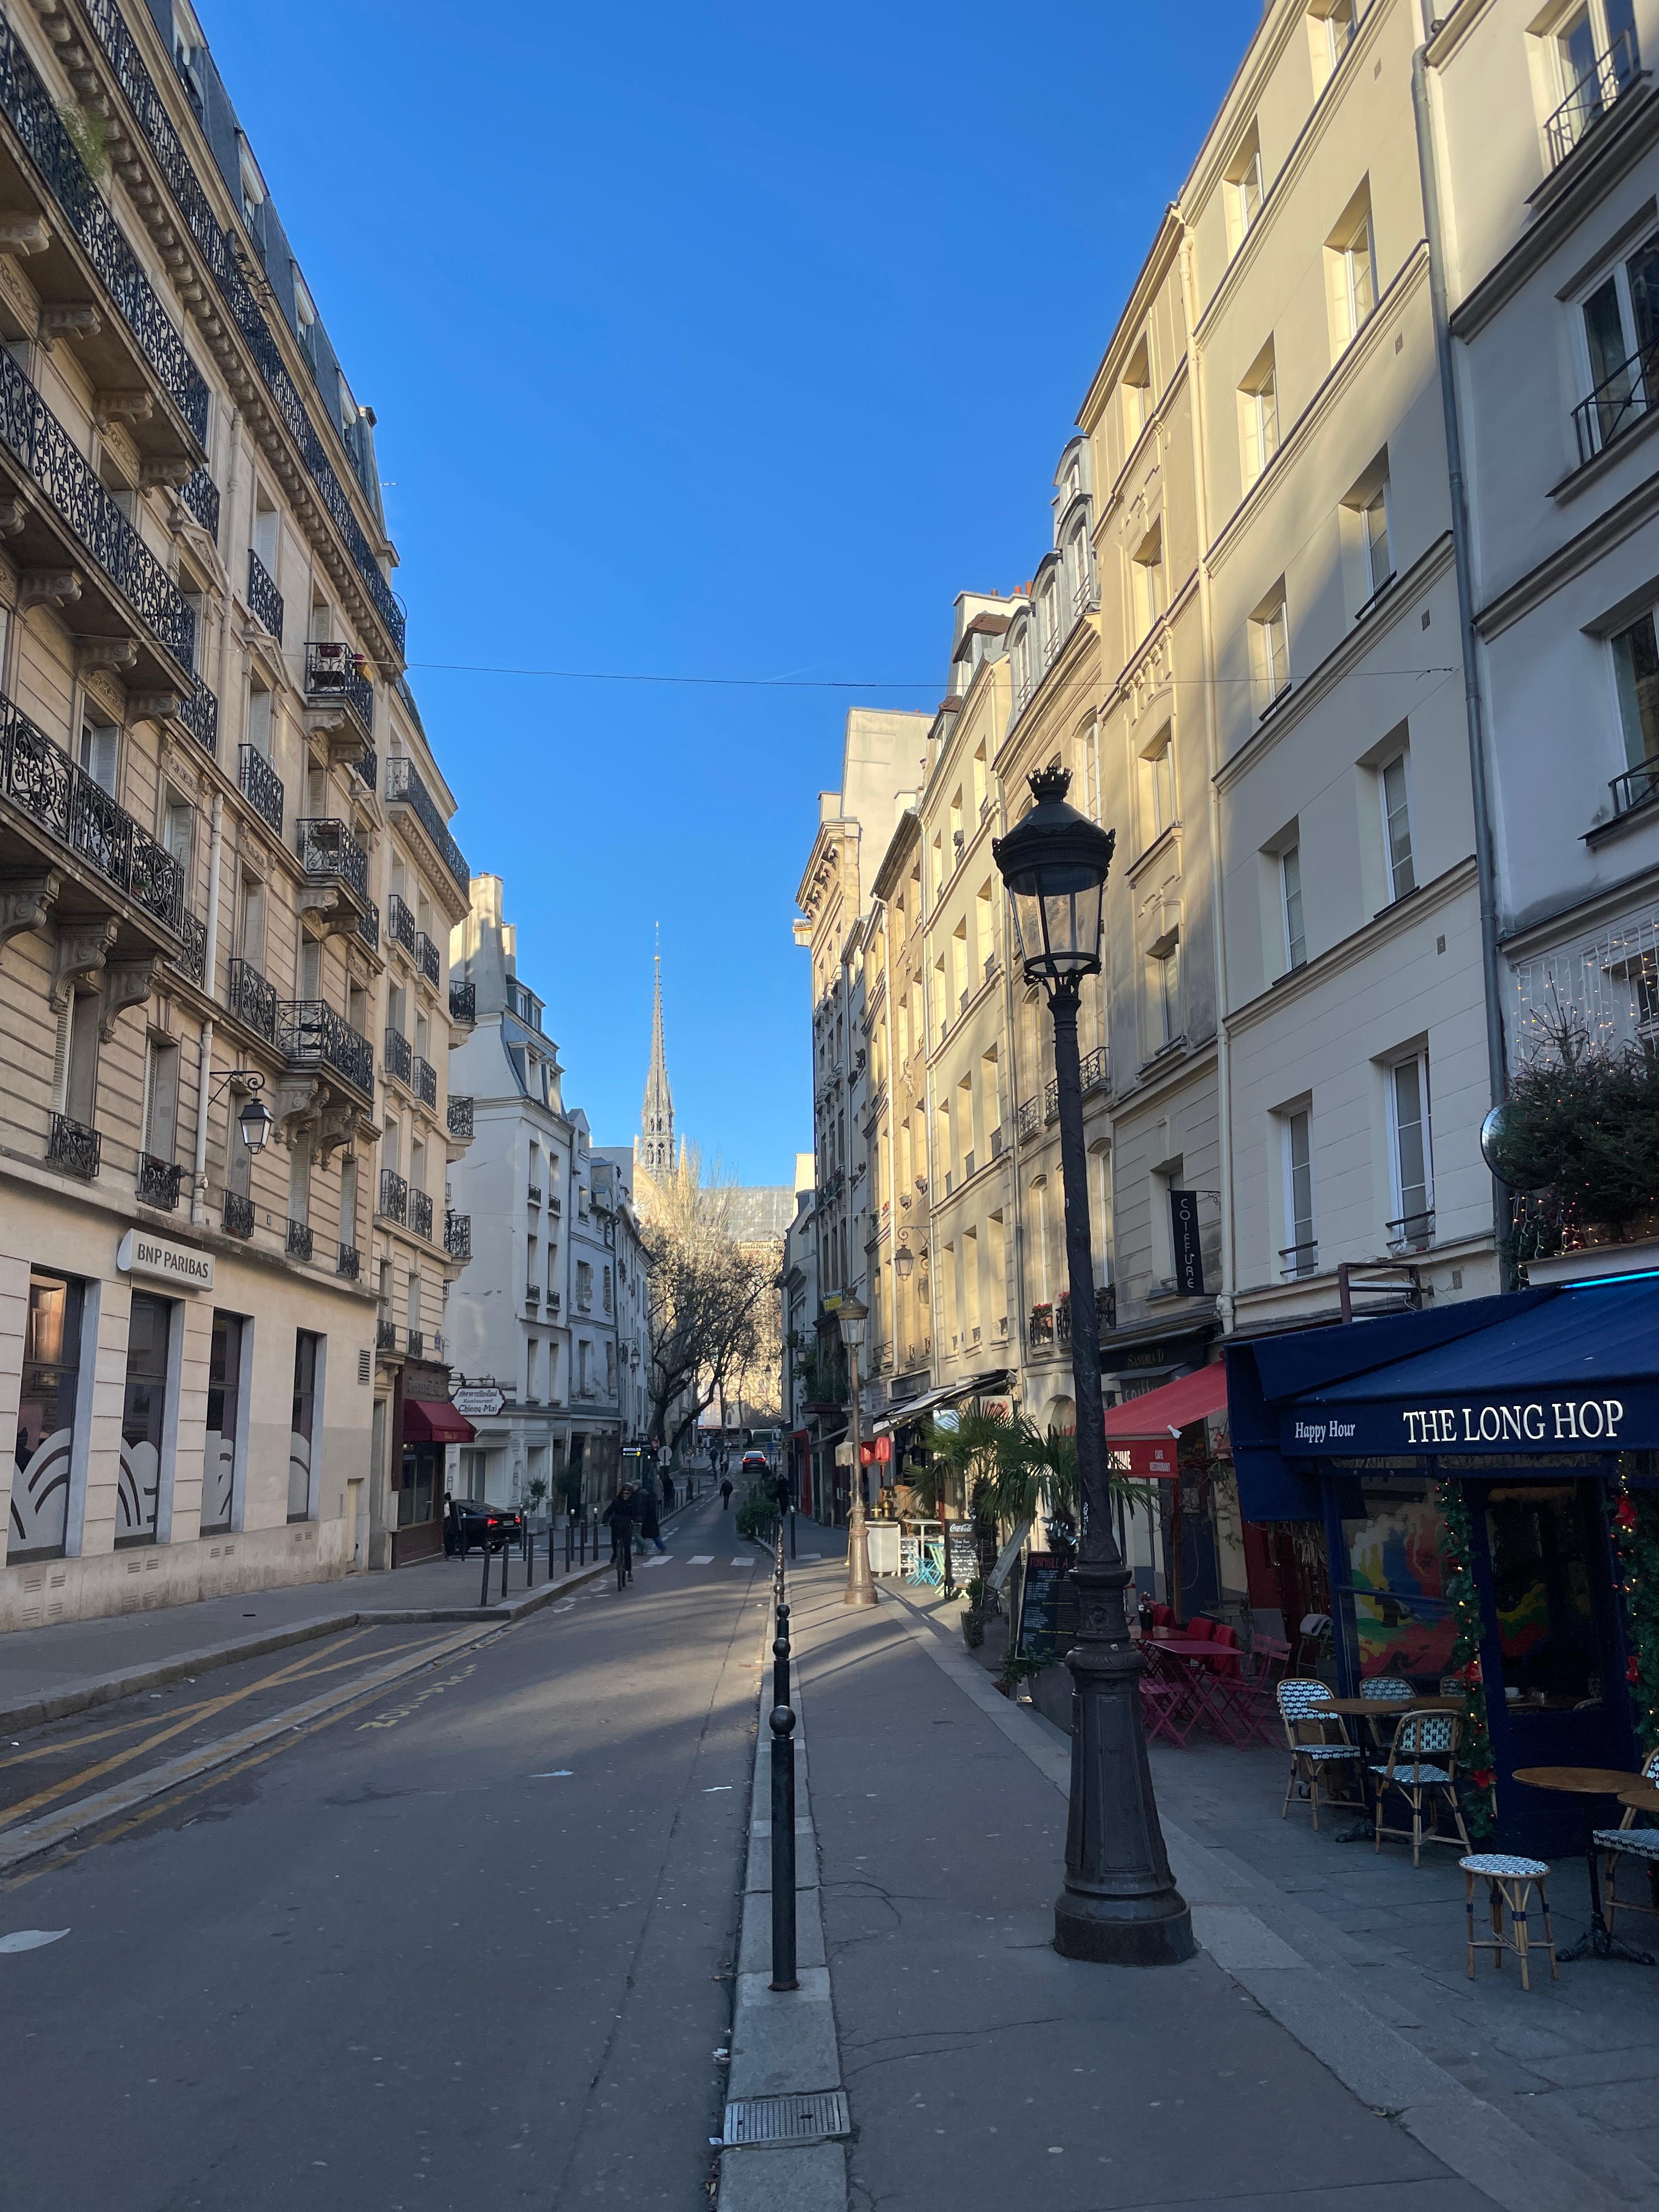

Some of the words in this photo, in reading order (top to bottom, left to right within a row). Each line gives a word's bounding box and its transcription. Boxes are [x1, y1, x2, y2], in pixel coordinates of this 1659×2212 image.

[138, 1243, 162, 1264] BNP
[164, 1251, 208, 1278] PARIBAS
[1180, 1198, 1195, 1288] COIFFURE
[1295, 1421, 1327, 1443] Happy
[1329, 1420, 1356, 1438] Hour
[1403, 1409, 1457, 1443] THE
[1462, 1404, 1545, 1442] LONG
[1551, 1400, 1623, 1438] HOP
[950, 1523, 973, 1532] Coca-Cola
